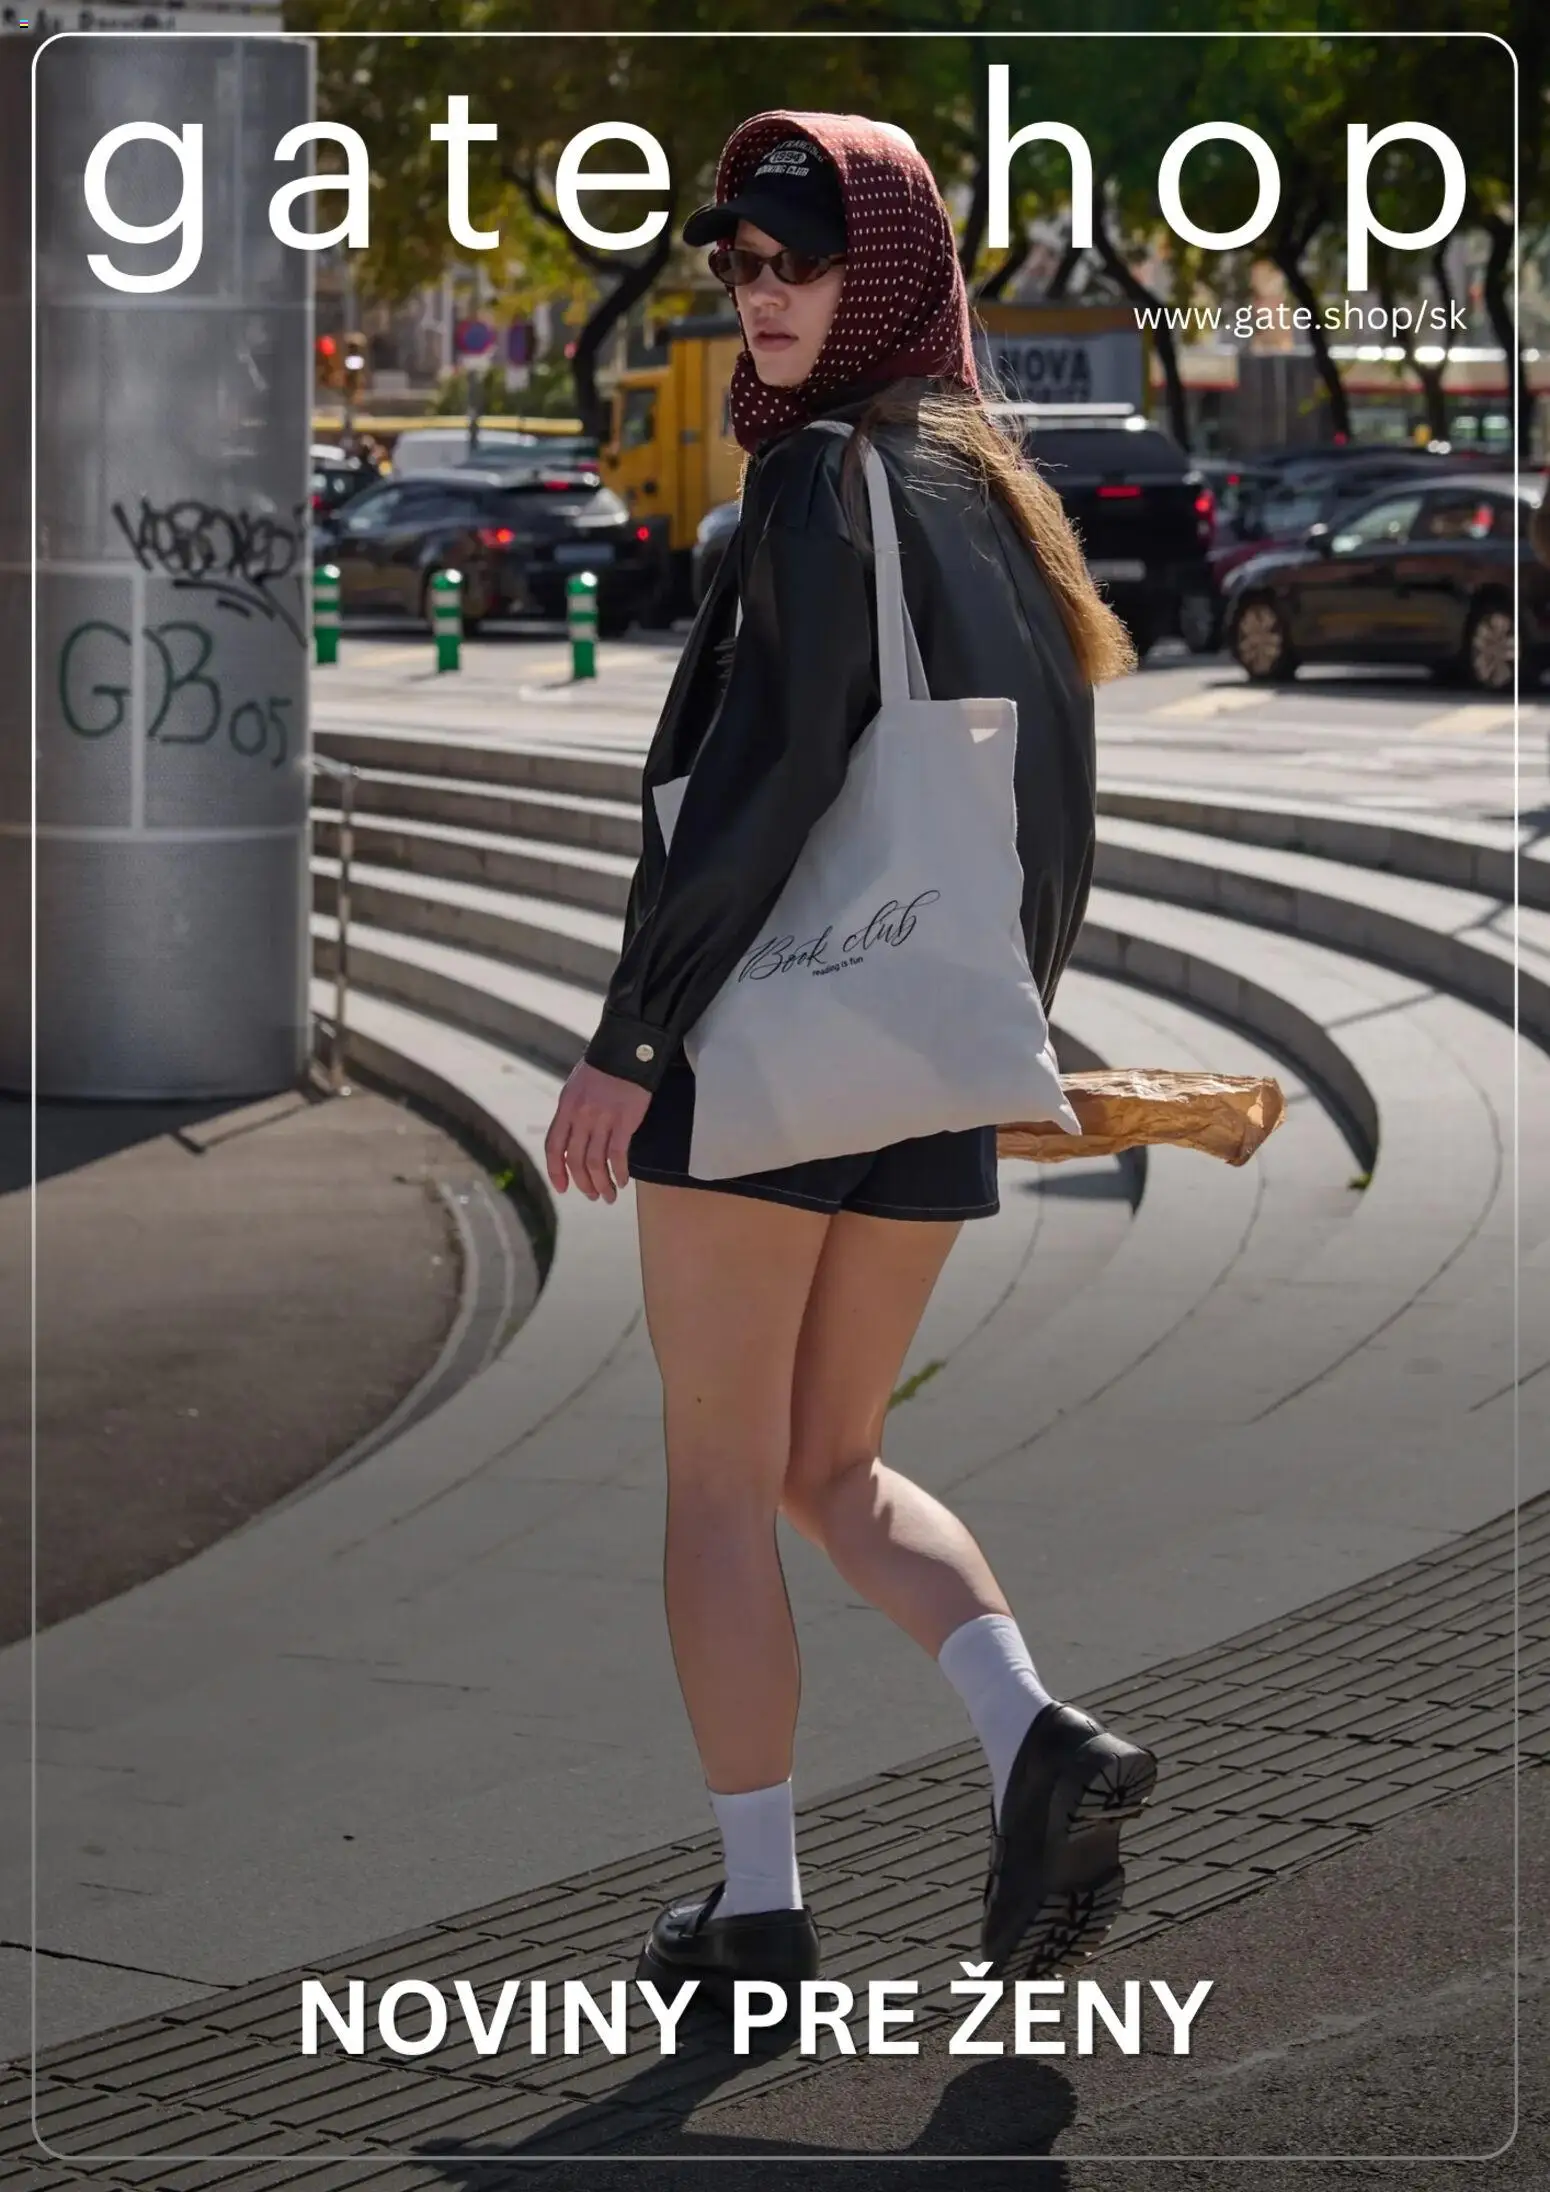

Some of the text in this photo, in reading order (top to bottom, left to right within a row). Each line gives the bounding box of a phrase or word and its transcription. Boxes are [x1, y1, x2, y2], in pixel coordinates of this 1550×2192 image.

[997, 347, 1093, 383] NOVA
[738, 889, 941, 983] Book club
[811, 955, 864, 977] reading is fun
